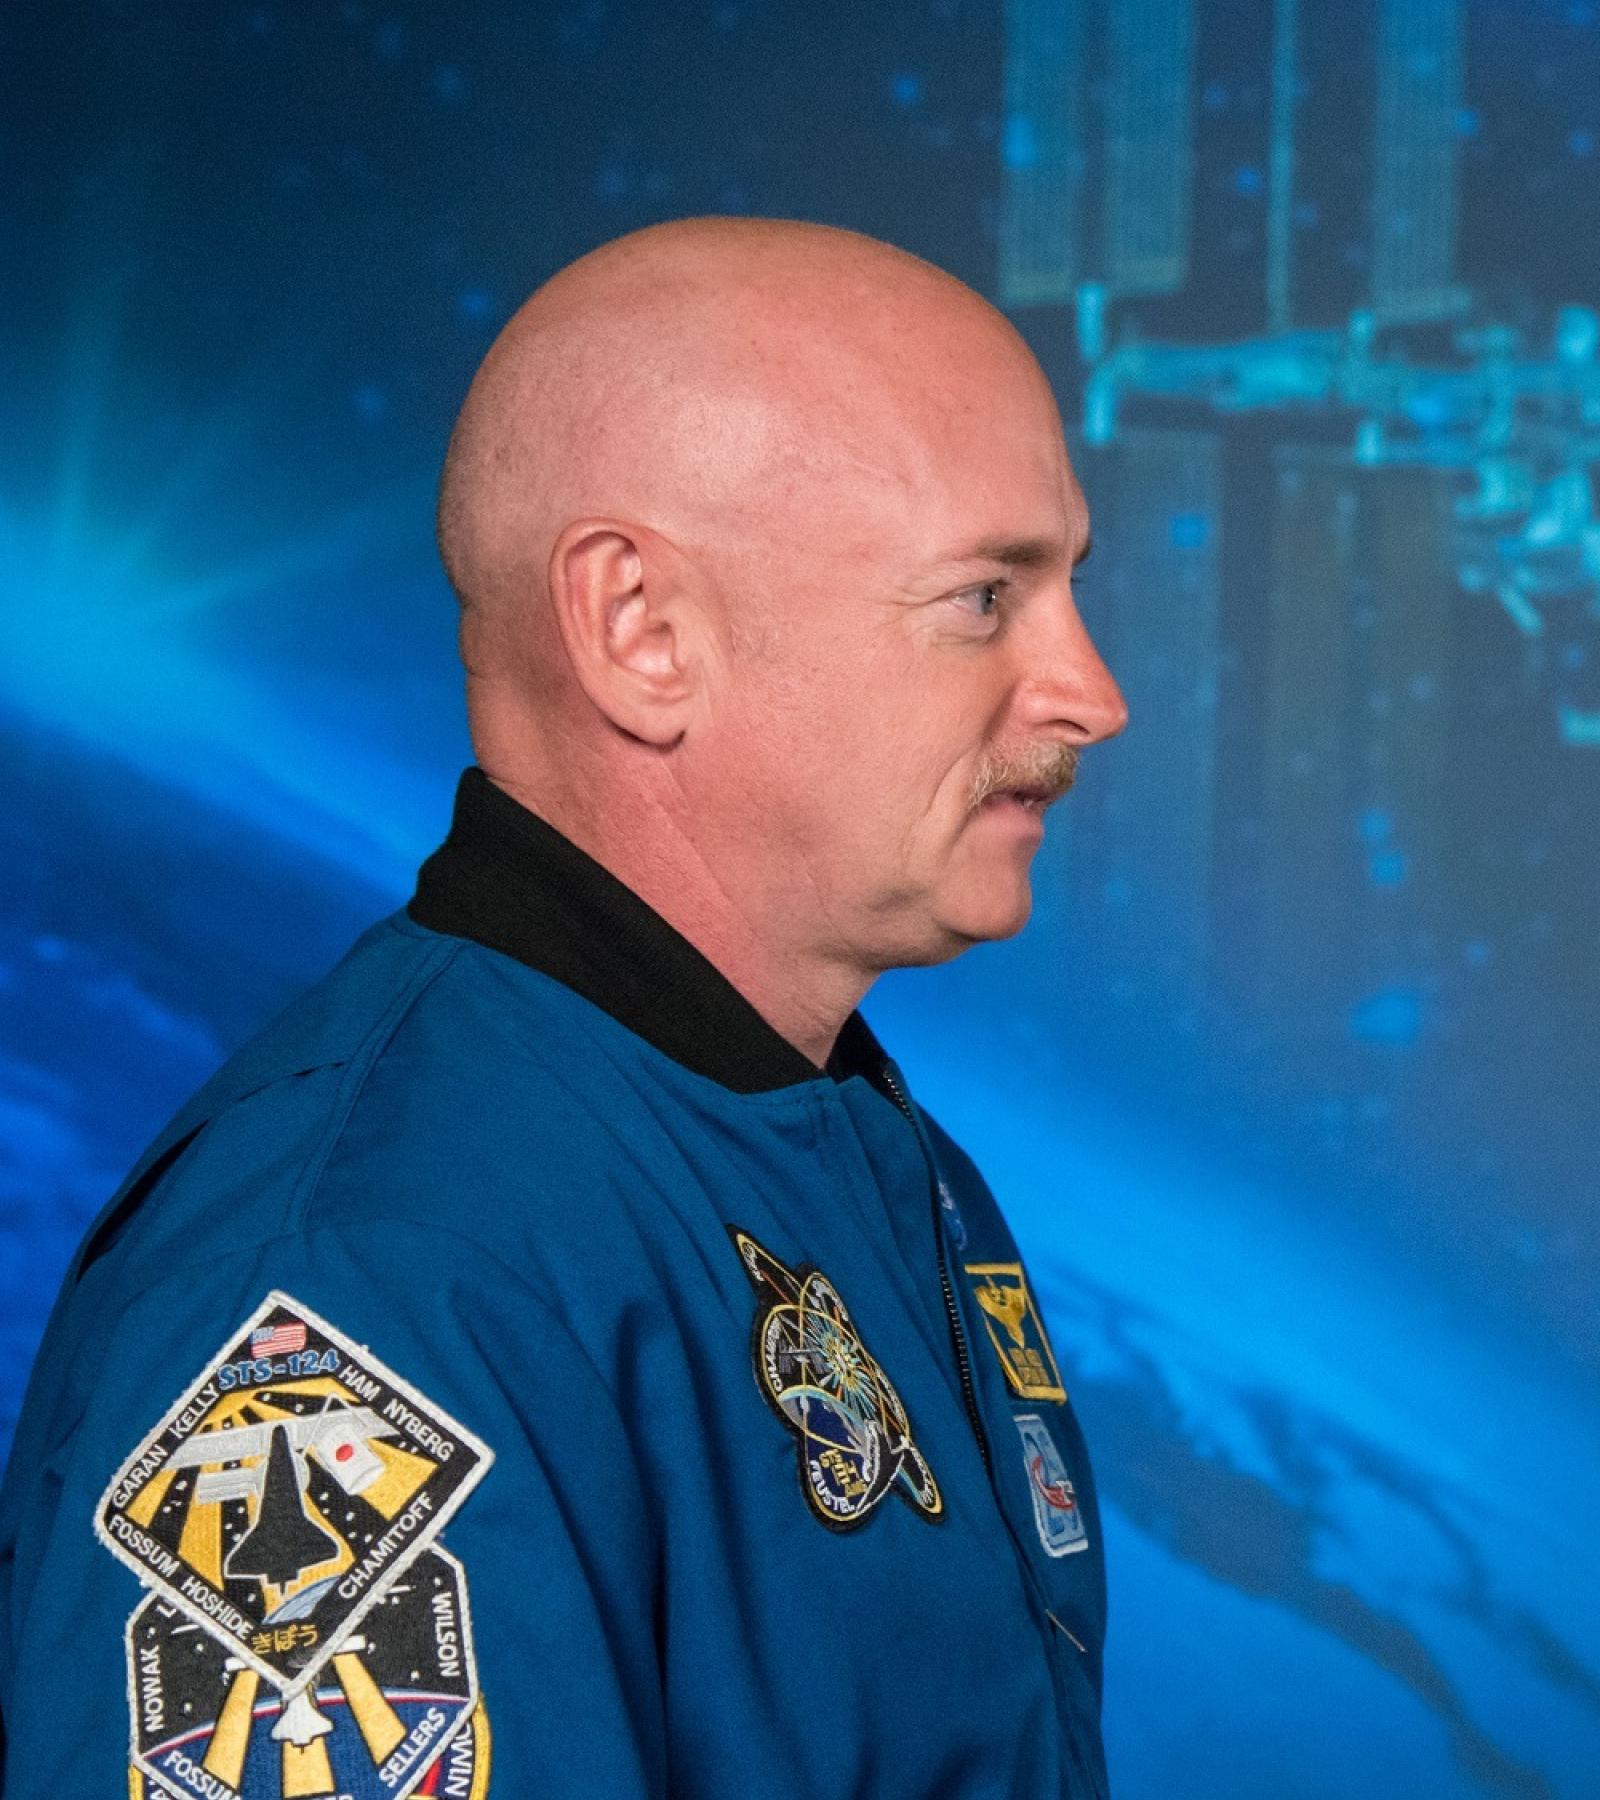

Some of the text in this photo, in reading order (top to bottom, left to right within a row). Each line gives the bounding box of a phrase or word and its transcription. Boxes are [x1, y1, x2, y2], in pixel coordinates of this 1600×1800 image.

[218, 1348, 340, 1390] STS-124
[338, 1365, 455, 1463] HAM NYBERG
[112, 1382, 221, 1509] GARAN KELLY
[108, 1515, 255, 1640] FOSSUM HOSHIDE
[337, 1491, 435, 1600] CHAMITOFF
[431, 1591, 461, 1678] WILSON
[139, 1644, 164, 1732] NOWAK
[378, 1706, 446, 1788] SELLERS
